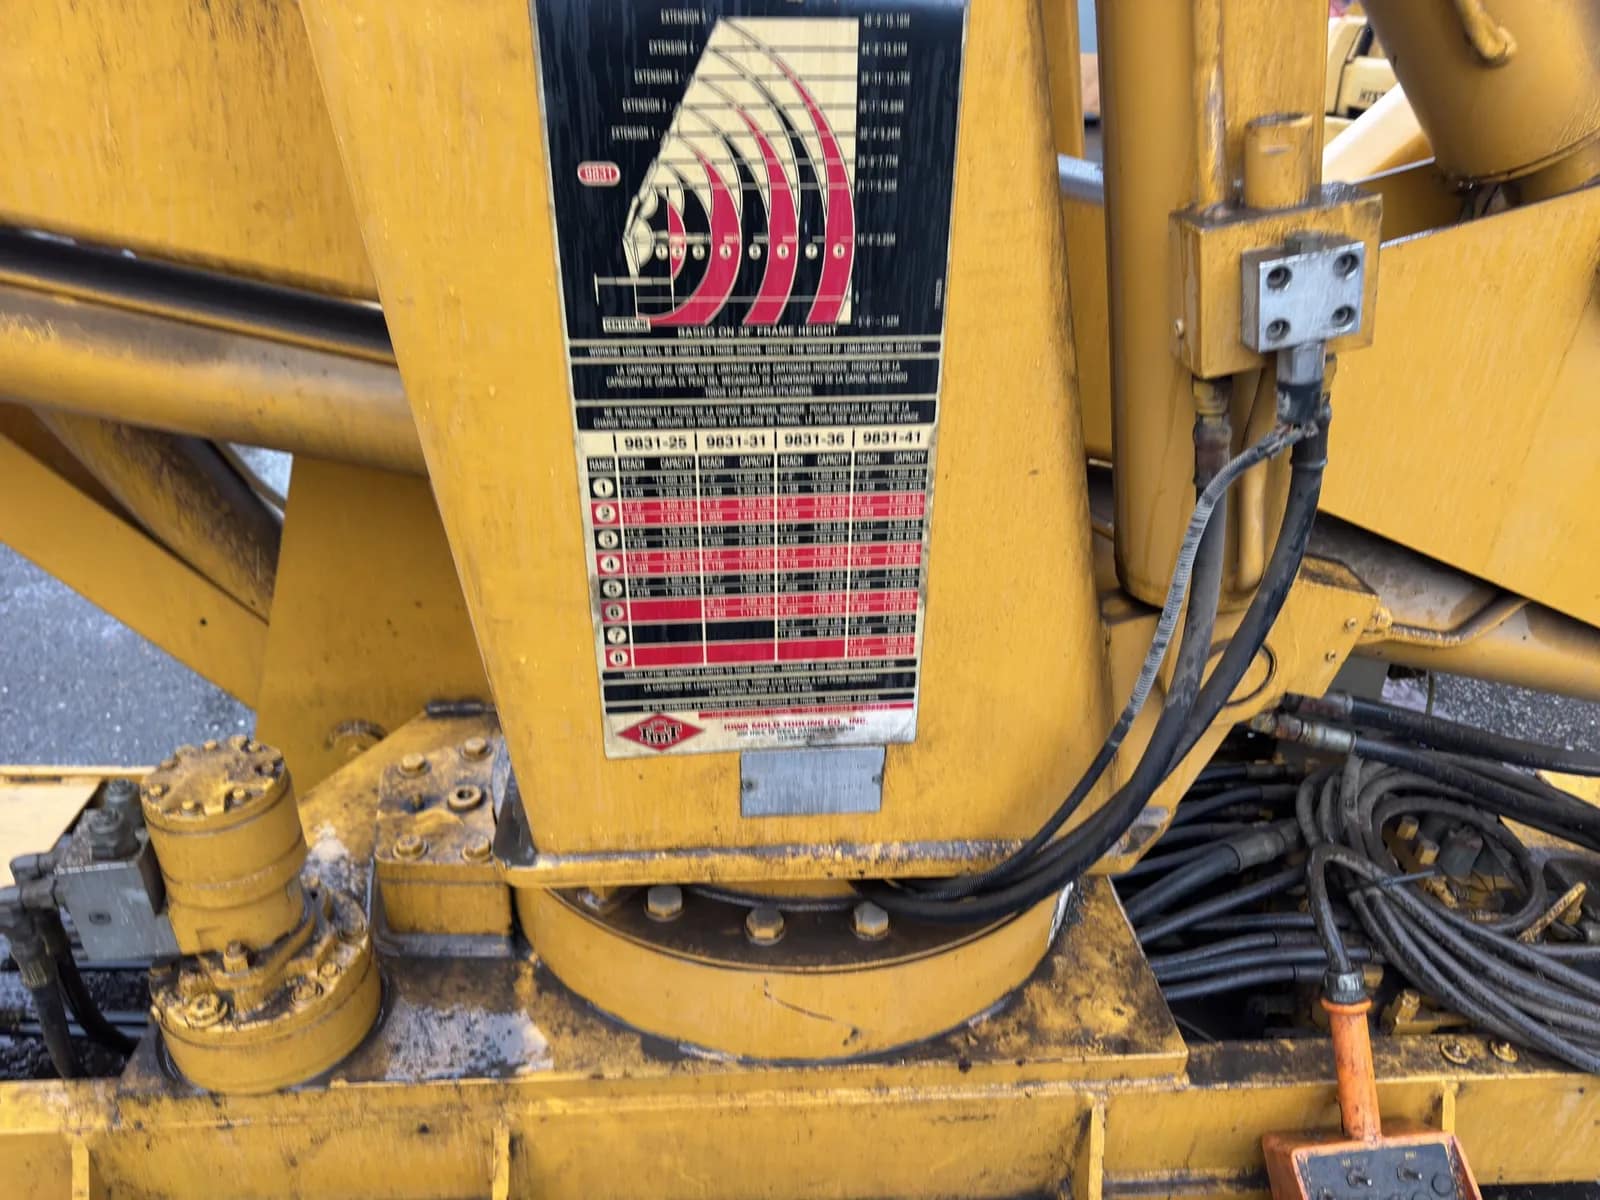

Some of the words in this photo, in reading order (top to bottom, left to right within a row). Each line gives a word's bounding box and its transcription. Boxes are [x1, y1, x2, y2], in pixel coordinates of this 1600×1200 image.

[660, 8, 700, 25] EXTENSION
[649, 39, 687, 55] EXTENSION
[634, 69, 672, 85] EXTENSION
[622, 98, 660, 113] EXTENSION
[611, 126, 649, 141] EXTENSION
[678, 327, 713, 338] BASED
[718, 326, 734, 338] ON
[757, 325, 794, 336] FRAME
[798, 325, 837, 336] HEIGHT
[624, 435, 687, 450] 9831-25
[706, 434, 766, 449] 9831-31
[784, 432, 845, 447] 9831-36
[863, 430, 922, 444] 9831-41
[589, 458, 614, 471] RANGE
[620, 458, 645, 470] REACH
[660, 457, 693, 470] CAPACITY
[700, 457, 725, 469] REACH
[739, 456, 771, 468] CAPACITY
[780, 455, 803, 467] REACH
[817, 454, 850, 467] CAPACITY
[857, 453, 880, 466] REACH
[893, 453, 925, 464] CAPACITY
[724, 723, 748, 731] IOWA
[751, 721, 781, 730] MOLD
[783, 719, 824, 729] TOOLING
